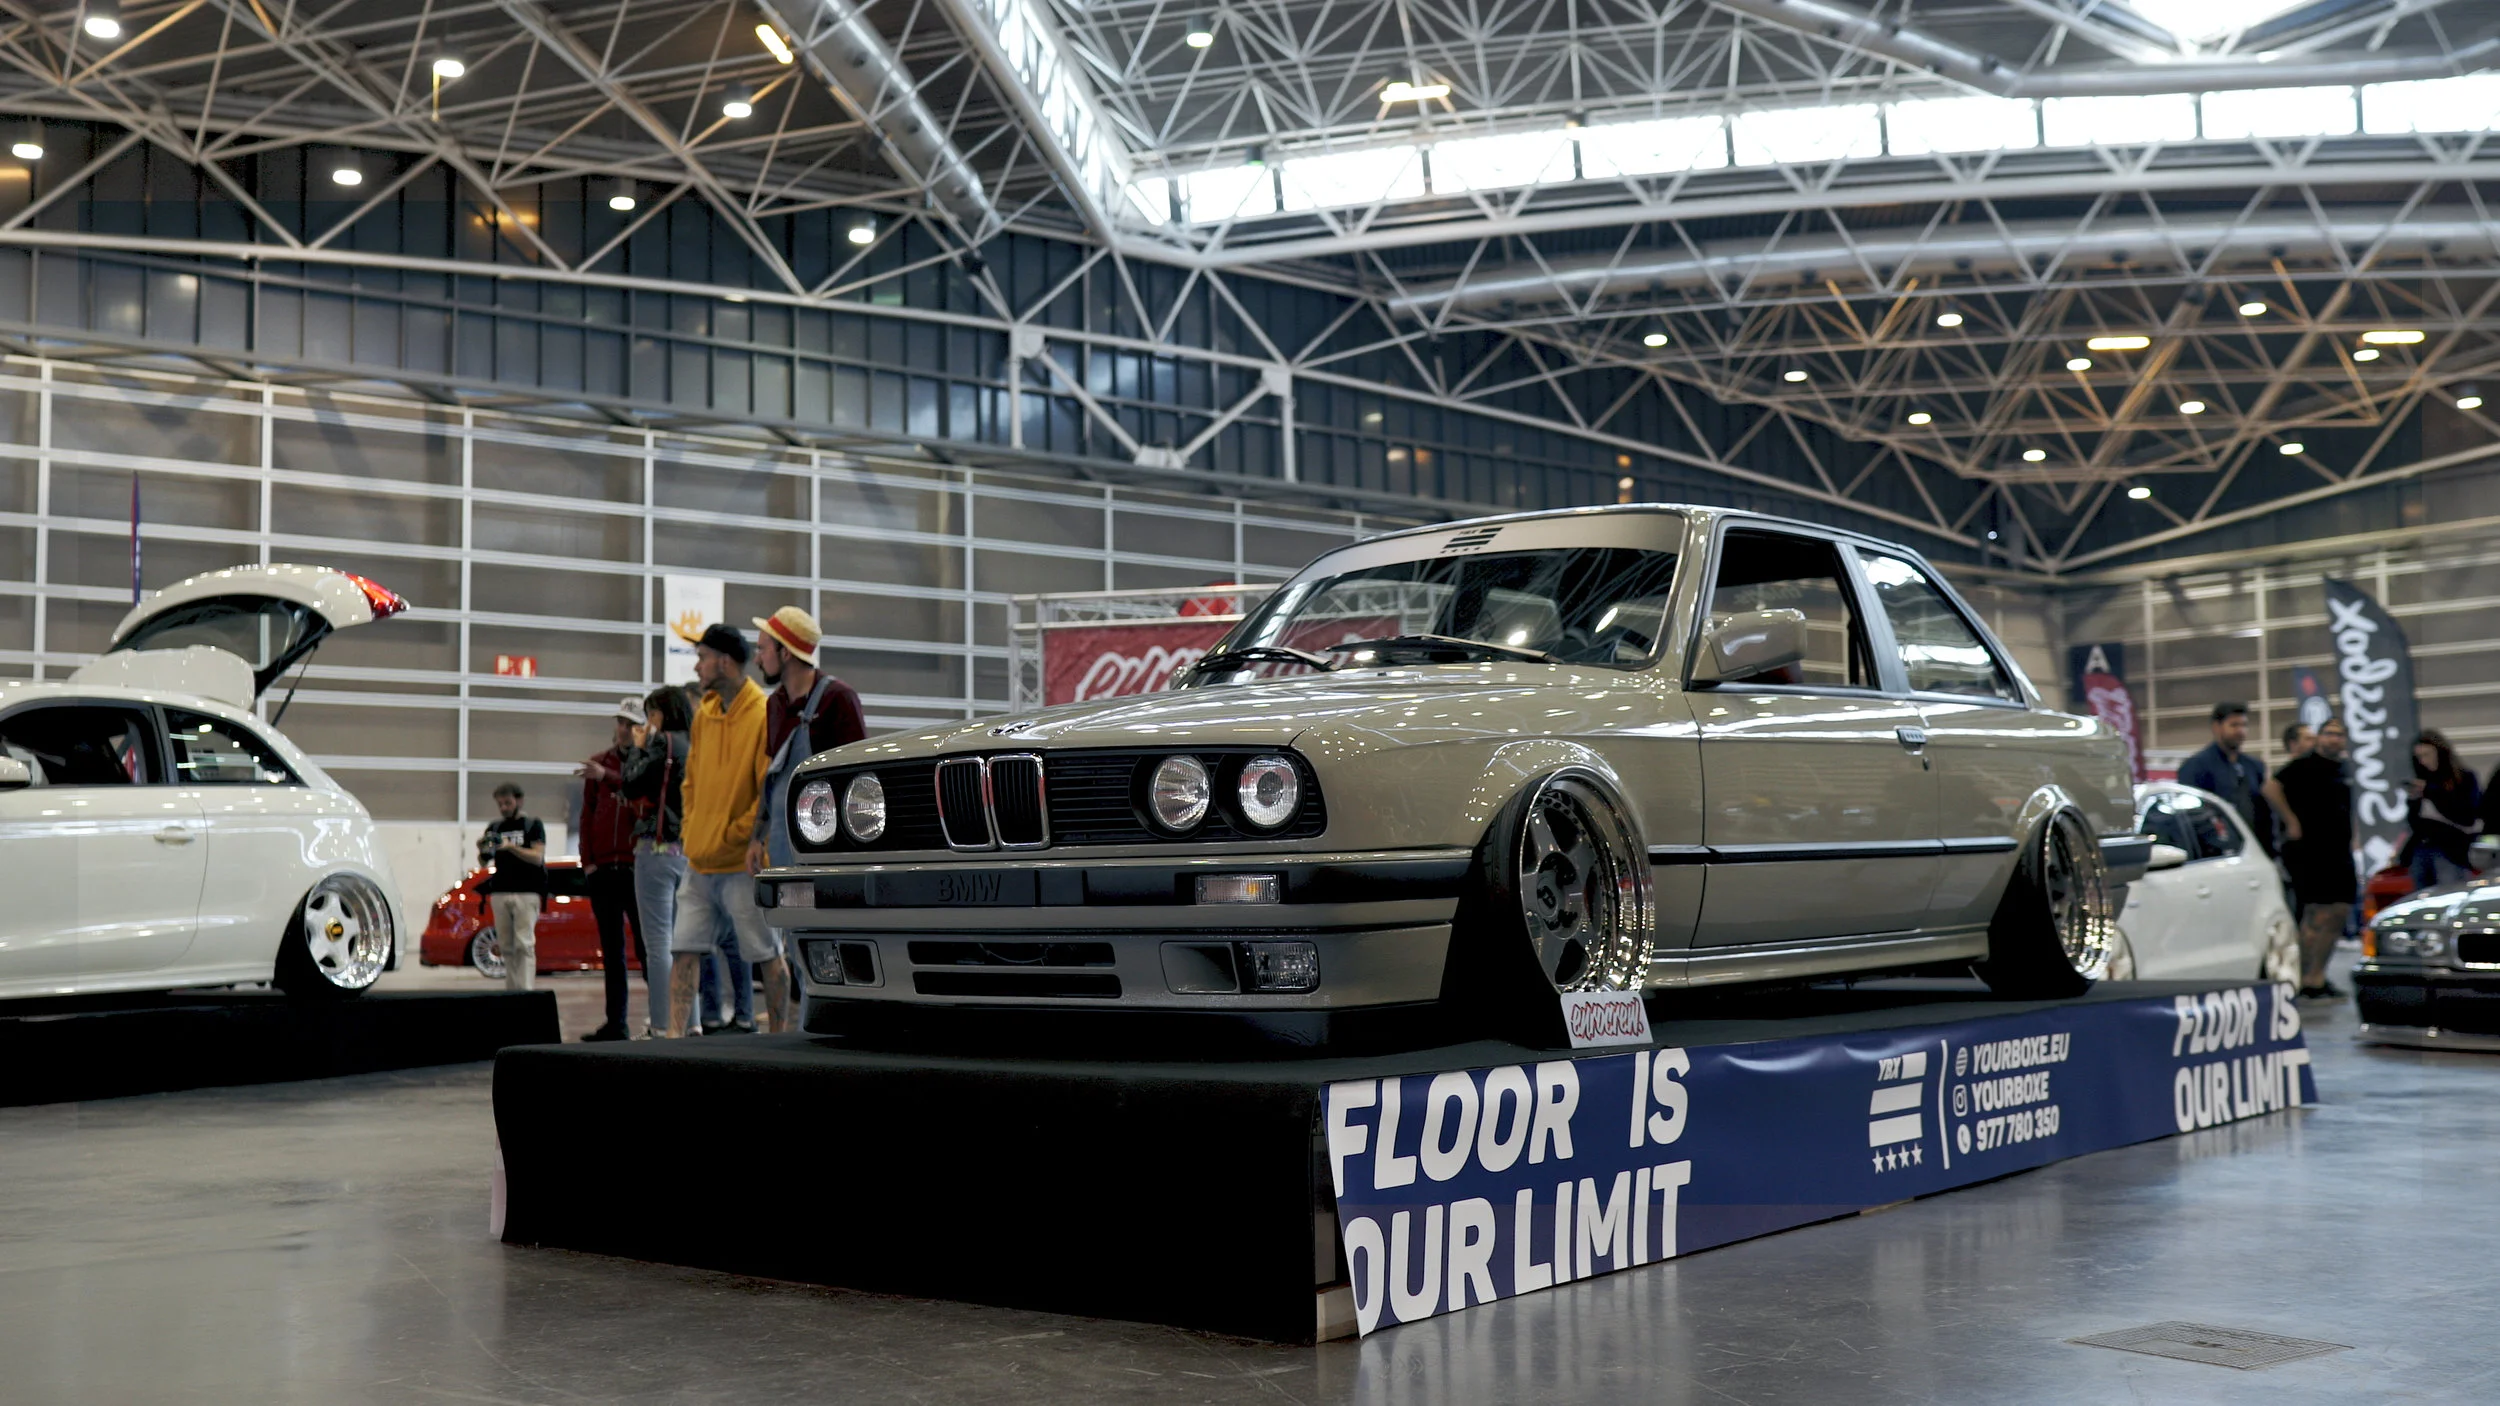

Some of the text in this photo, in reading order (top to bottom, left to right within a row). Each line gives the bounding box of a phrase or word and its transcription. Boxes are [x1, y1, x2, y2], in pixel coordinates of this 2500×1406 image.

[2085, 644, 2112, 674] A
[937, 873, 1002, 903] BMW
[2173, 982, 2300, 1057] FLOOR IS
[1877, 1056, 1902, 1082] YBX
[1973, 1033, 2071, 1075] YOURBOXE.EU
[1971, 1071, 2050, 1113] YOURBOXE
[2174, 1047, 2311, 1133] OUR LIMIT
[1328, 1047, 1692, 1199] FLOOR IS
[1976, 1105, 2060, 1152] 977 780 350
[1344, 1160, 1692, 1340] OUR LIMIT
